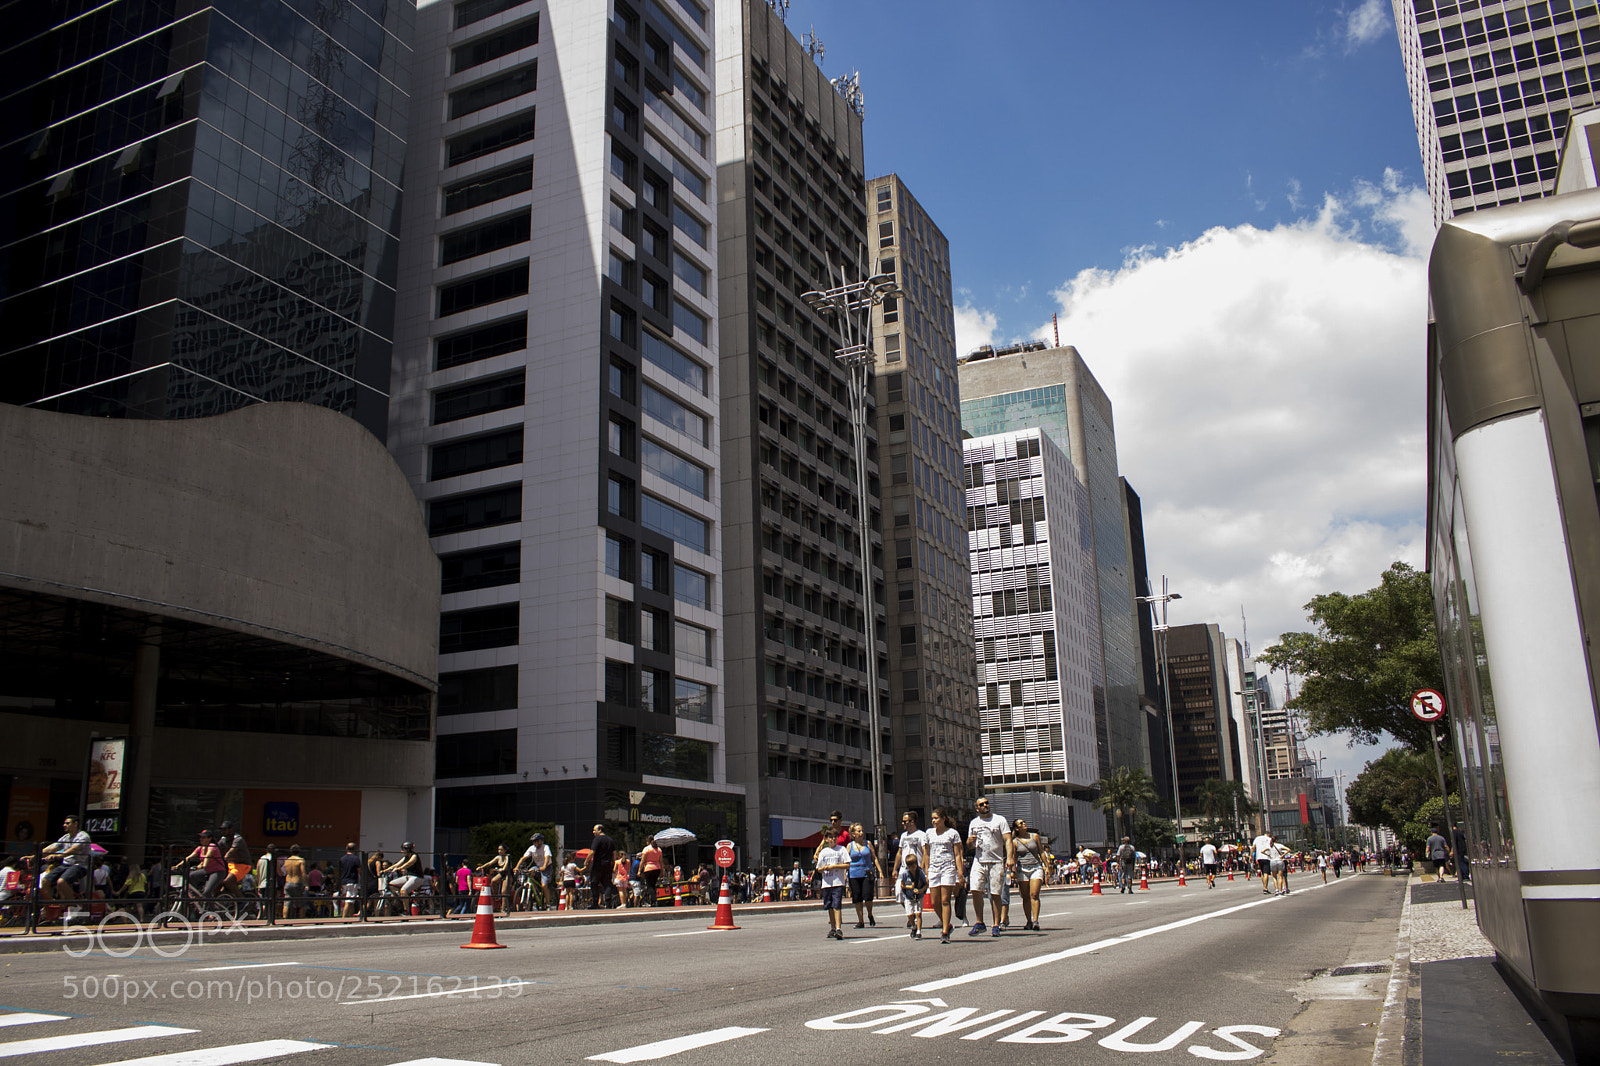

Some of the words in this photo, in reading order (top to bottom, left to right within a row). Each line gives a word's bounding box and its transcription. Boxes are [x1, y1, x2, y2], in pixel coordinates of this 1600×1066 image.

[100, 752, 117, 761] KFC
[86, 818, 113, 832] 12:42
[266, 818, 297, 831] Itaú
[641, 813, 672, 824] McDonald's
[804, 997, 1282, 1061] ÔNIBUS
